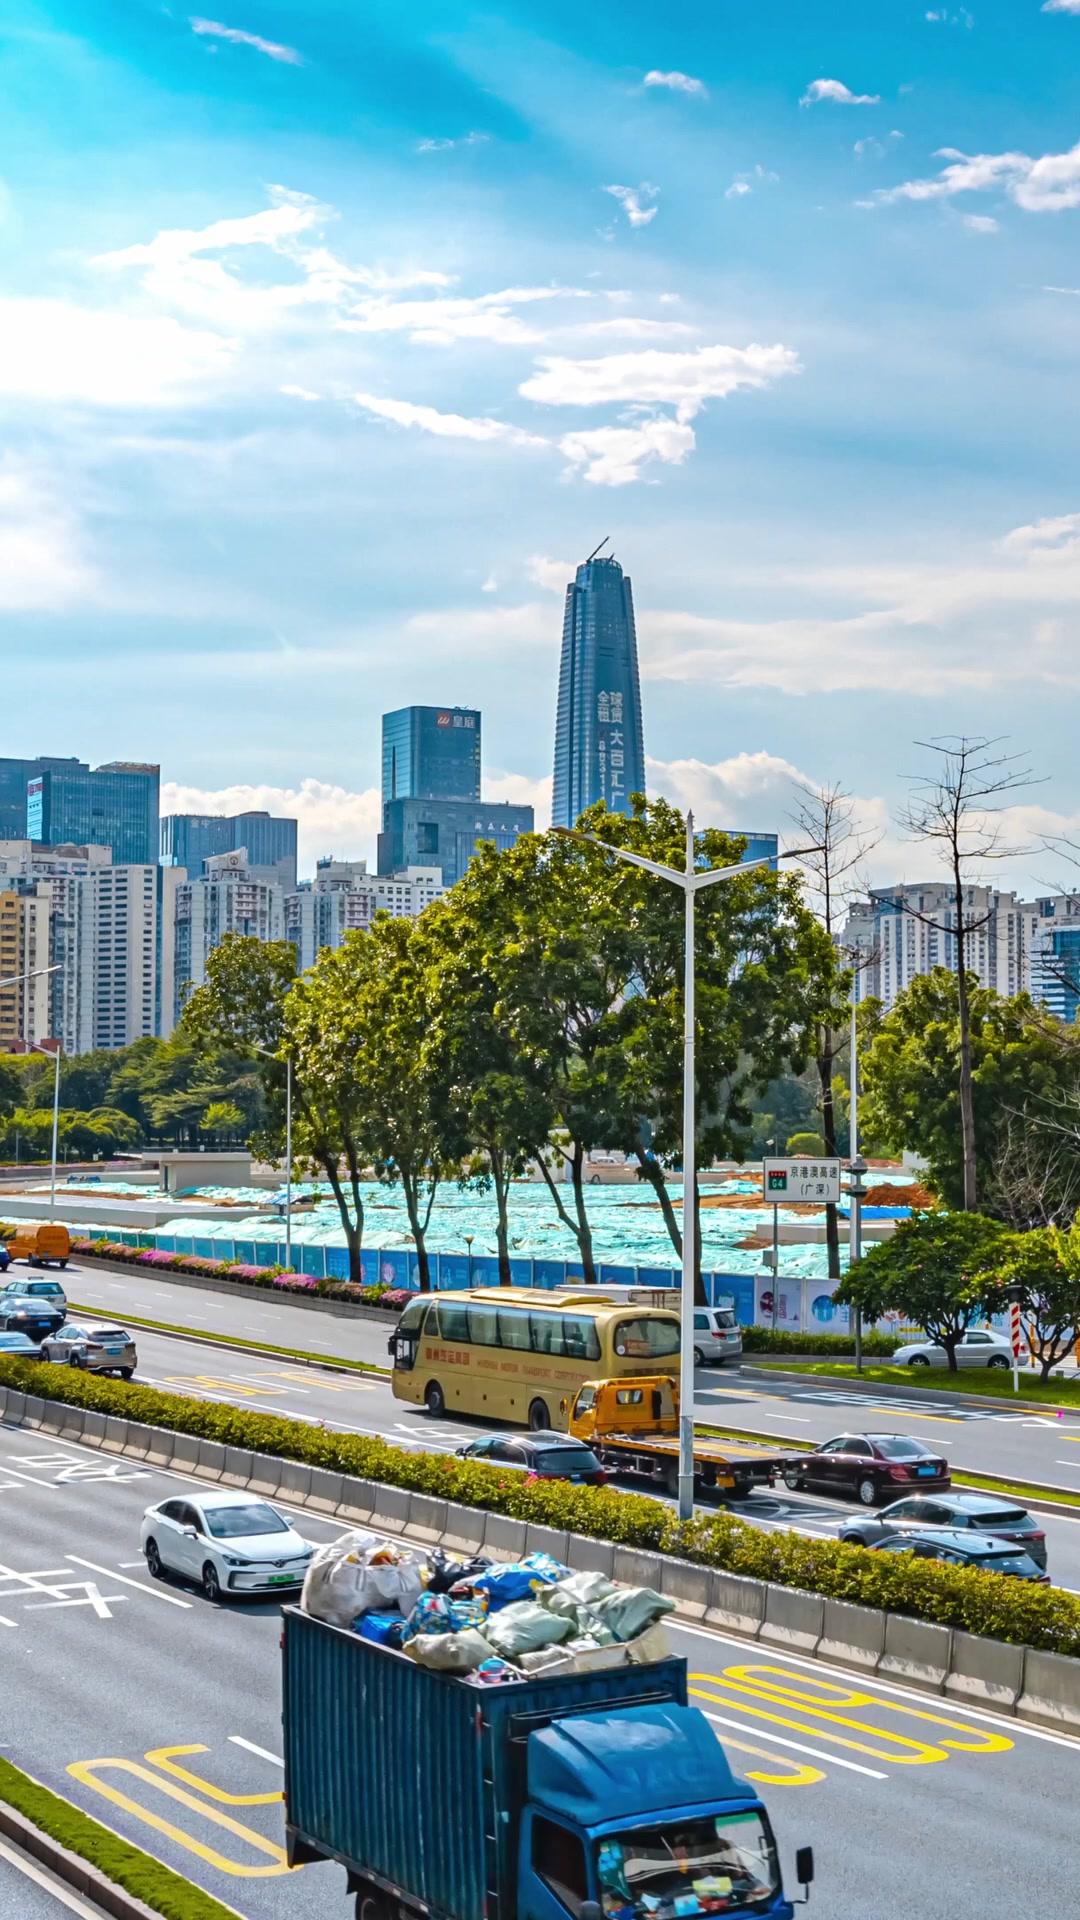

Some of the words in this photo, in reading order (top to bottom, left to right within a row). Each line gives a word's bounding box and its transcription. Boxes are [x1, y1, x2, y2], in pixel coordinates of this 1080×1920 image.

[790, 1166, 838, 1178] 京港澳高速
[771, 1178, 783, 1188] G4
[800, 1183, 830, 1196] (广深)
